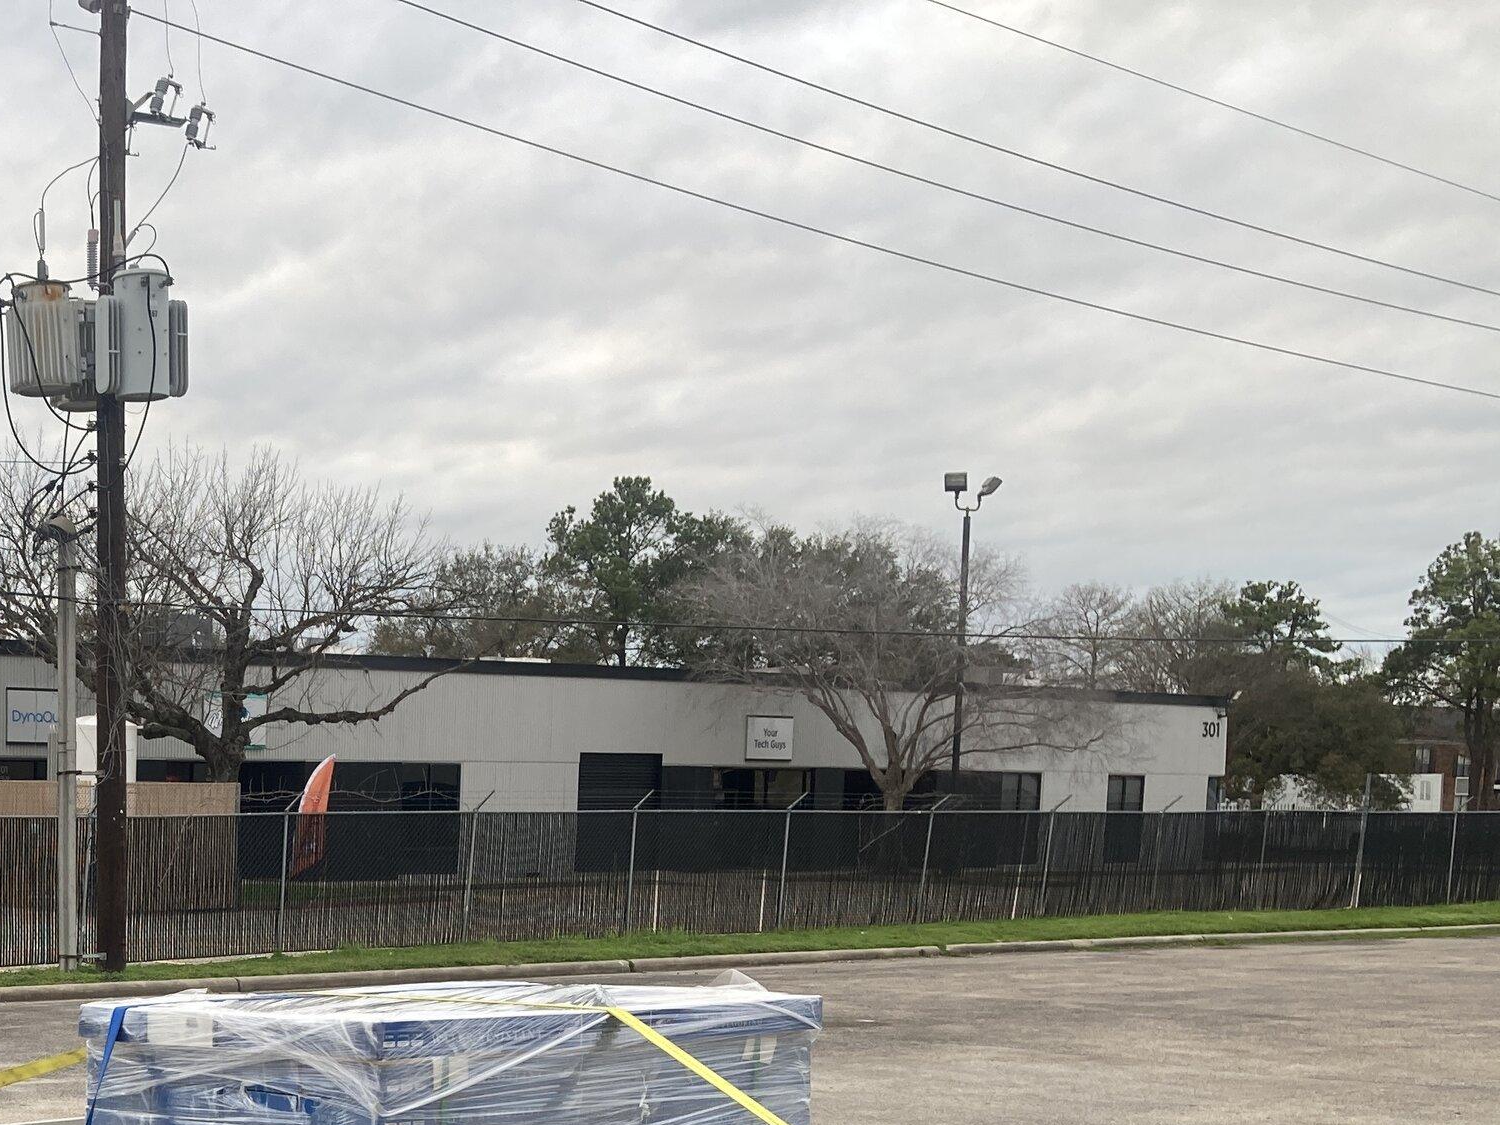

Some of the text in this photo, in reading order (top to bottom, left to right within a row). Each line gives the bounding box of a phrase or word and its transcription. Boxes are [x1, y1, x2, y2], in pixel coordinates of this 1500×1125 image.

[763, 728, 778, 738] Your
[1202, 721, 1220, 738] 301
[754, 739, 787, 751] Tech Guys
